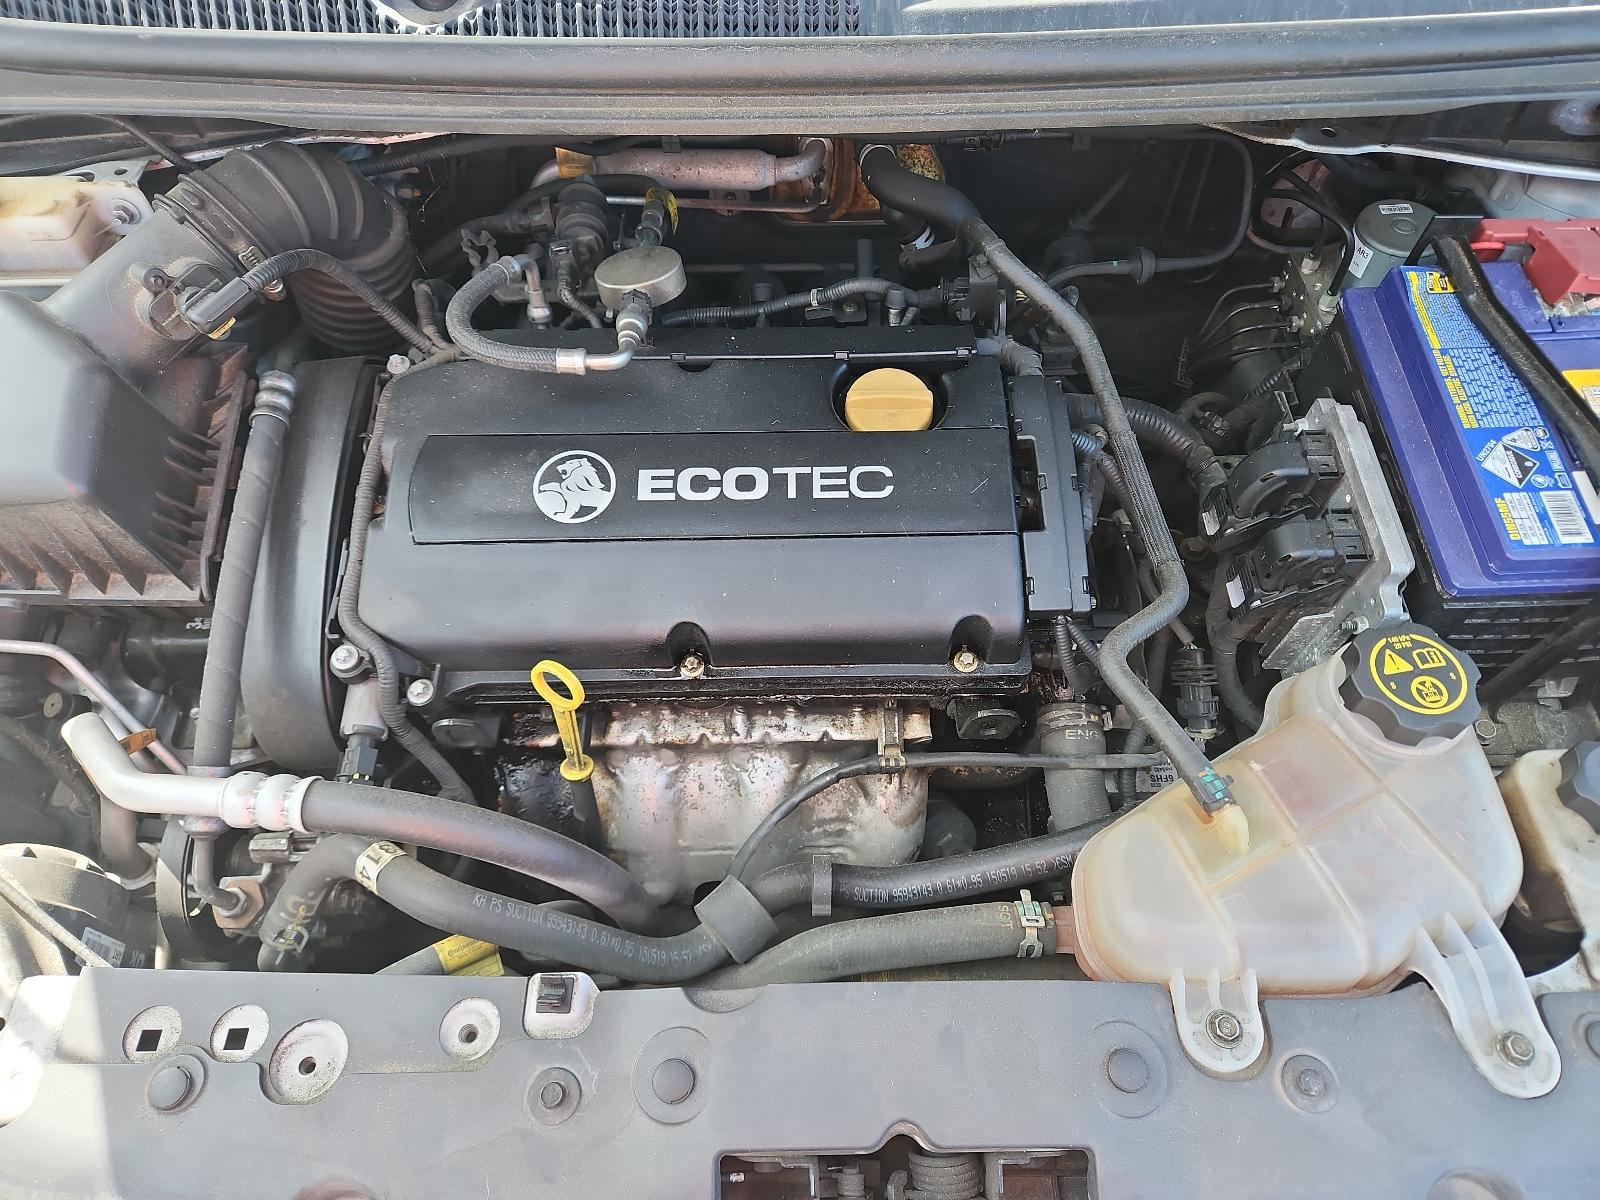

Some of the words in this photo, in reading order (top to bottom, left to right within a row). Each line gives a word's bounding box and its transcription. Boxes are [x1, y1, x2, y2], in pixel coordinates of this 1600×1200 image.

[1356, 246, 1370, 260] AR3
[637, 465, 895, 501] ECOTEC
[1065, 729, 1100, 741] ENG
[1150, 774, 1174, 783] 6FHS
[853, 886, 889, 903] SUCTION
[892, 882, 934, 903] 95943143
[986, 867, 1018, 885] 150519
[473, 893, 488, 909] KH
[490, 897, 503, 913] PS
